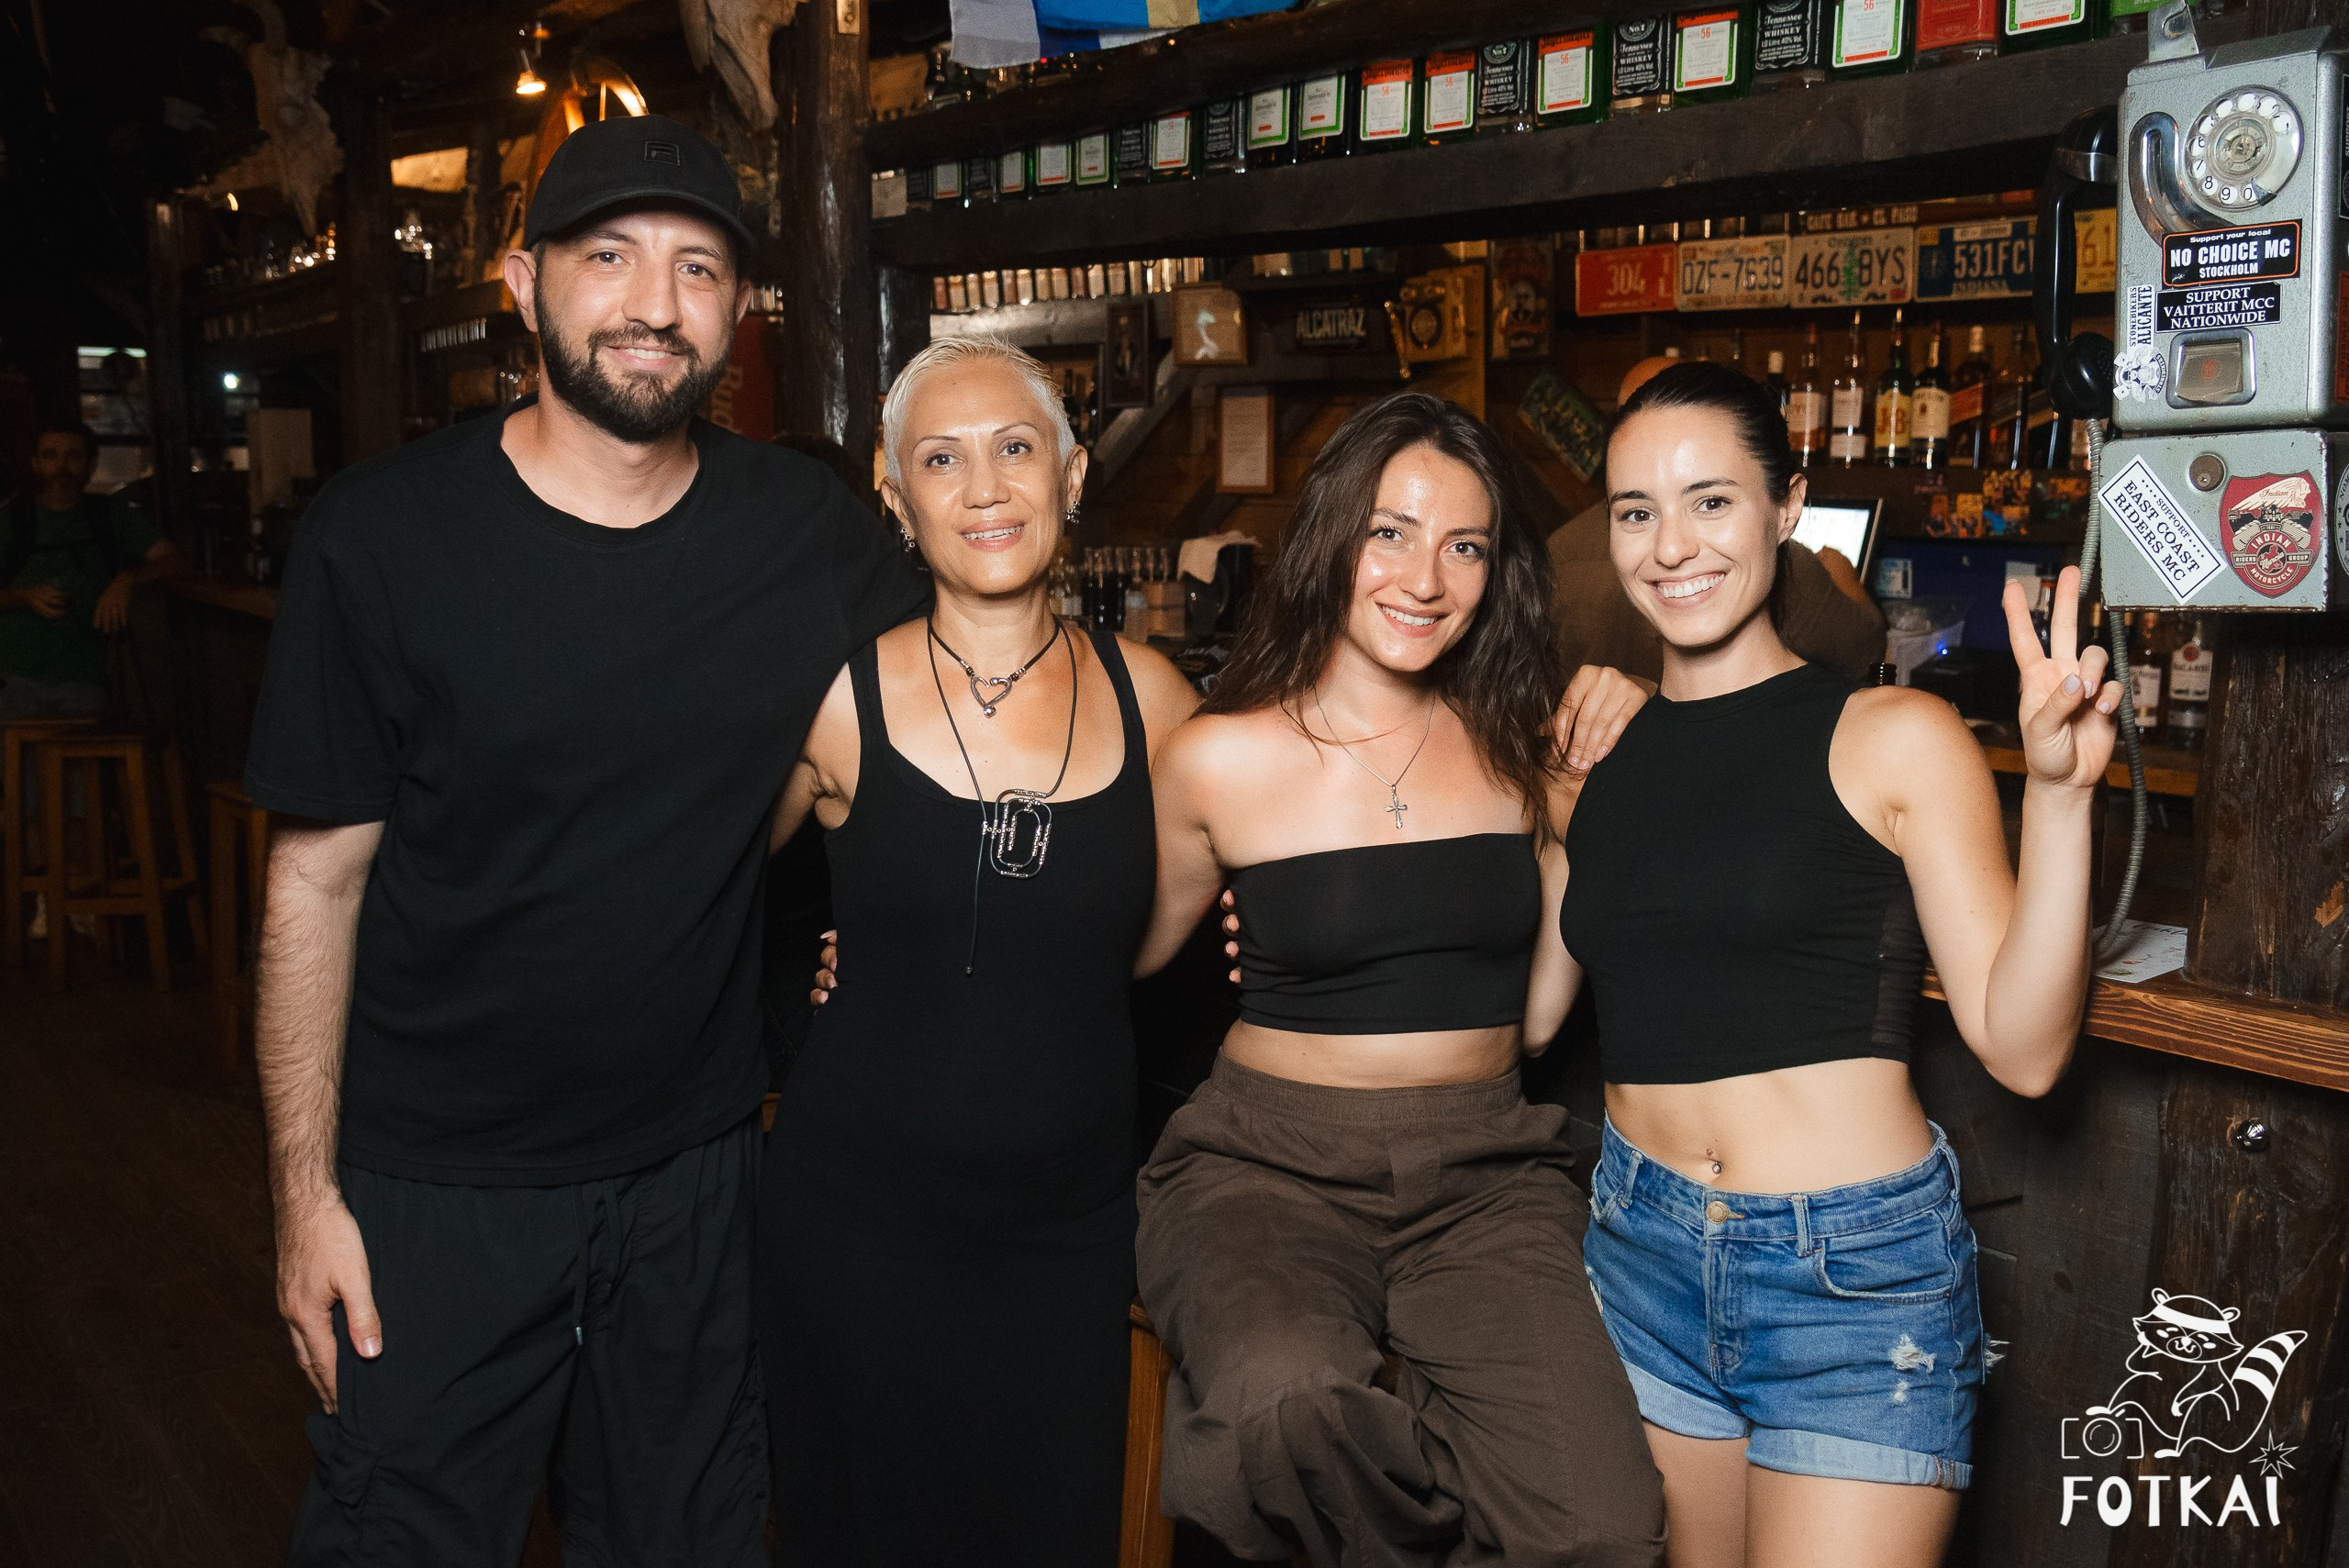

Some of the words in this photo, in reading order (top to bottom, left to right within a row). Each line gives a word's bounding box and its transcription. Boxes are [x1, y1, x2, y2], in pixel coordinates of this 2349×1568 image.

[1764, 14, 1803, 26] Tennessee
[1764, 26, 1801, 39] WHISKEY
[1620, 54, 1653, 65] WHISKEY
[2204, 175, 2213, 190] 8
[2221, 187, 2231, 201] 9
[2243, 187, 2253, 201] 0
[2189, 233, 2224, 243] Support
[2226, 230, 2246, 240] your
[2248, 228, 2271, 237] local
[1954, 239, 2035, 280] 531FC
[2170, 248, 2192, 268] NO
[2198, 240, 2259, 265] CHOICE
[2265, 238, 2291, 259] MC
[1795, 250, 1841, 290] 466
[1858, 245, 1907, 287] BYS
[2199, 261, 2259, 279] STOCKHOLM
[1606, 261, 1647, 296] 304
[2186, 286, 2251, 304] SUPPORT
[2137, 285, 2153, 346] ALICANTE
[2163, 300, 2239, 317] VAITTERIT
[2241, 296, 2276, 312] MCC
[1296, 306, 1366, 339] ALCATRAZ
[2170, 310, 2266, 329] NATIONWIDE
[1876, 407, 1906, 435] JB
[2259, 489, 2289, 498] Indian
[2123, 479, 2160, 521] EAST
[2156, 521, 2200, 573] COAST
[2155, 497, 2191, 539] SUPPORT
[2113, 492, 2165, 554] RIDERS
[2161, 553, 2187, 581] MC
[2251, 532, 2291, 549] INDIAN
[2235, 555, 2256, 563] RIDERS
[2250, 567, 2293, 584] MOTORCYCLE
